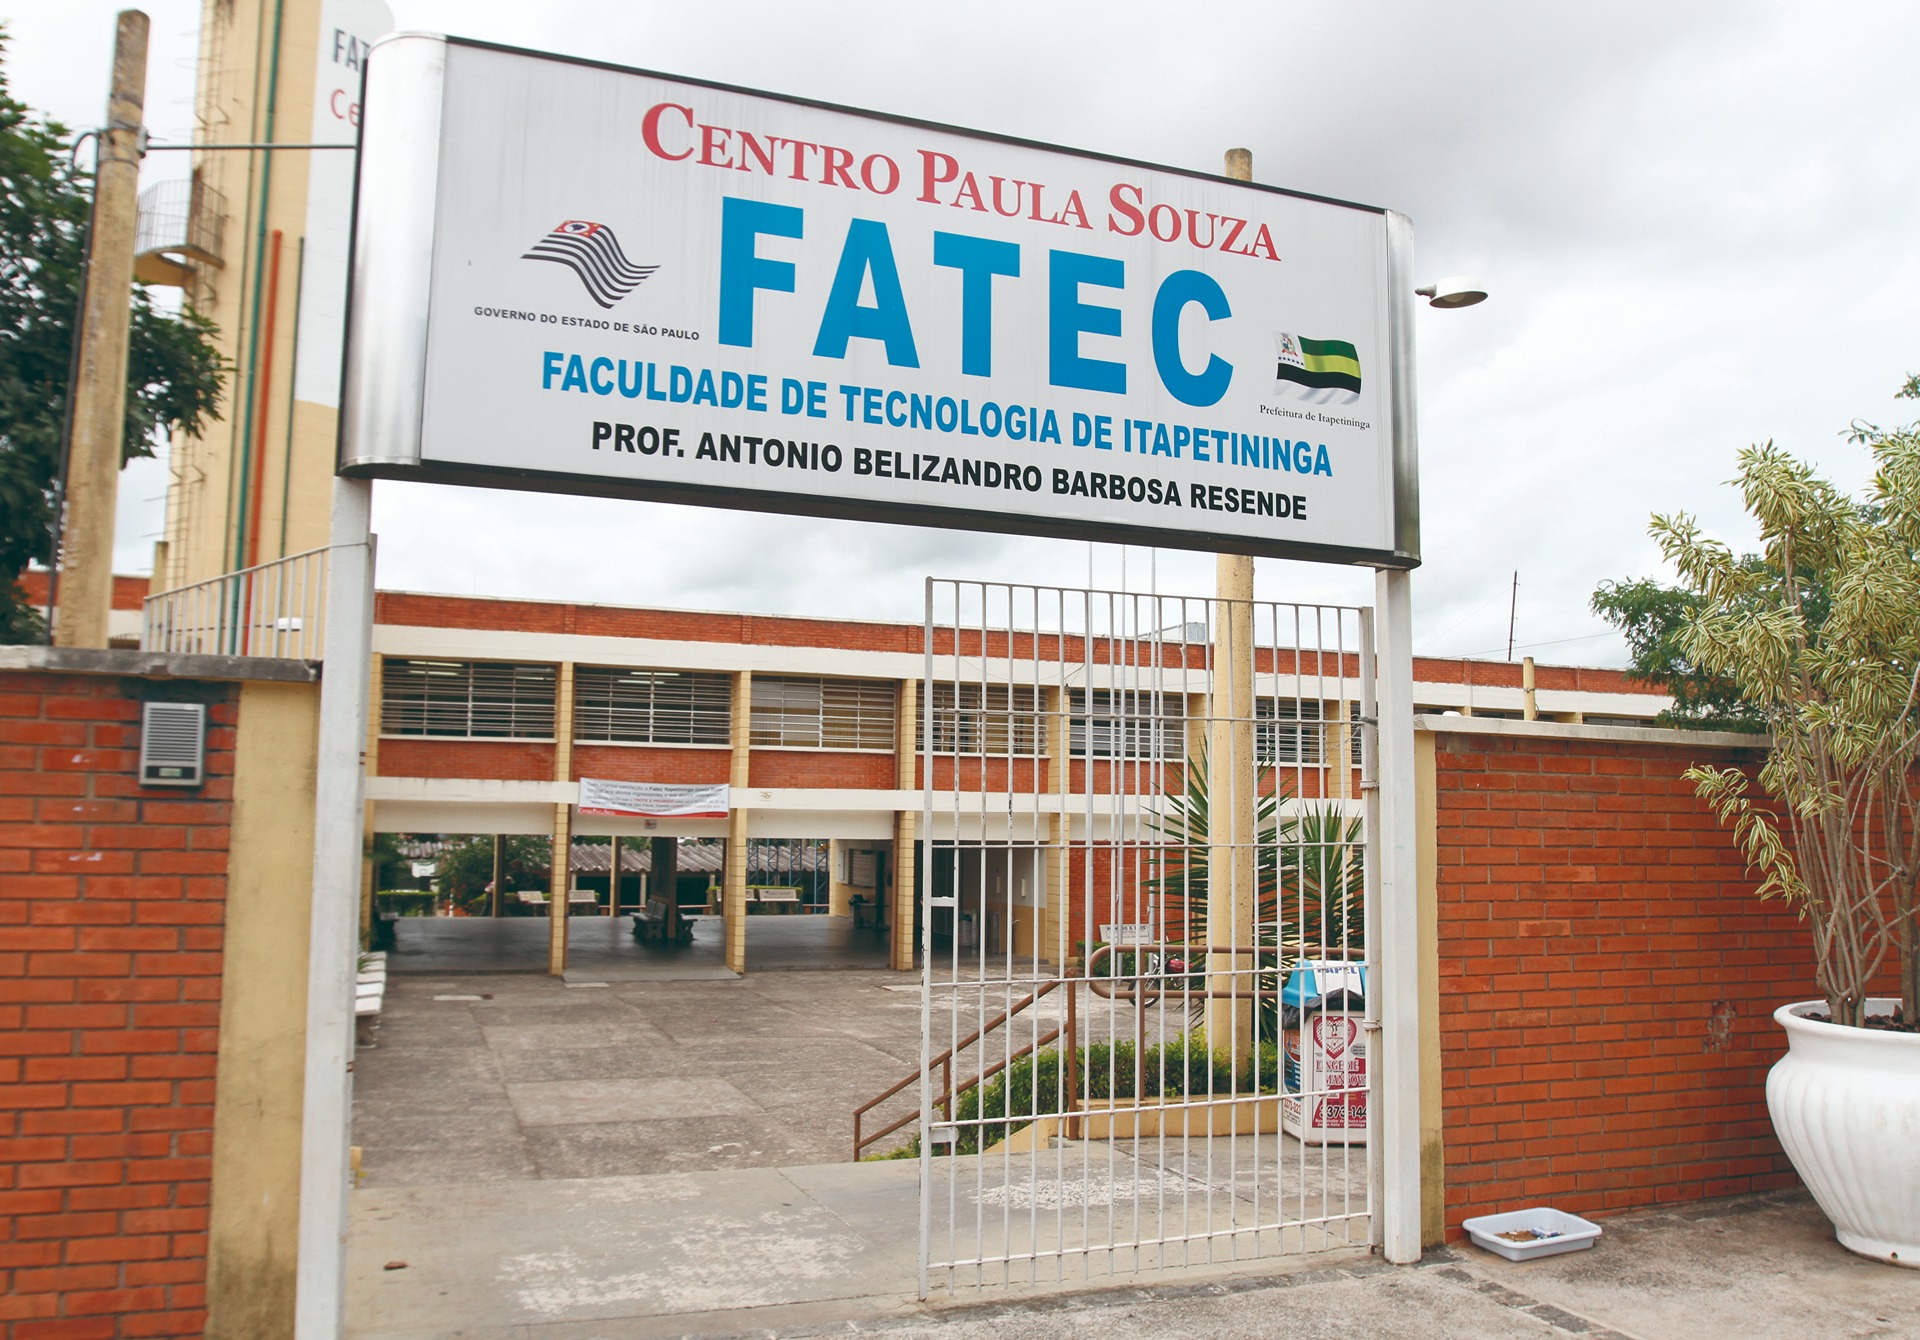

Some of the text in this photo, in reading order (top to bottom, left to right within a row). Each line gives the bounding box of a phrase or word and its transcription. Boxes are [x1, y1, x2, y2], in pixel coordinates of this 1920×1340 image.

[642, 104, 1280, 261] CENTRO PAULA SOUZA
[474, 306, 700, 341] GOVERNO DO ESTADO DE SÃO PAULO
[718, 195, 1234, 408] FATEC
[542, 351, 1333, 477] FACULDADE DE TECNOLOGIA DE ITAPETININGA
[1259, 404, 1371, 430] Prefeitura de Itapetininga
[592, 421, 1307, 521] PROF. ANTONIO BELIZANDRO BARBOSA RESENDE
[1315, 1060, 1359, 1071] LNGEIE
